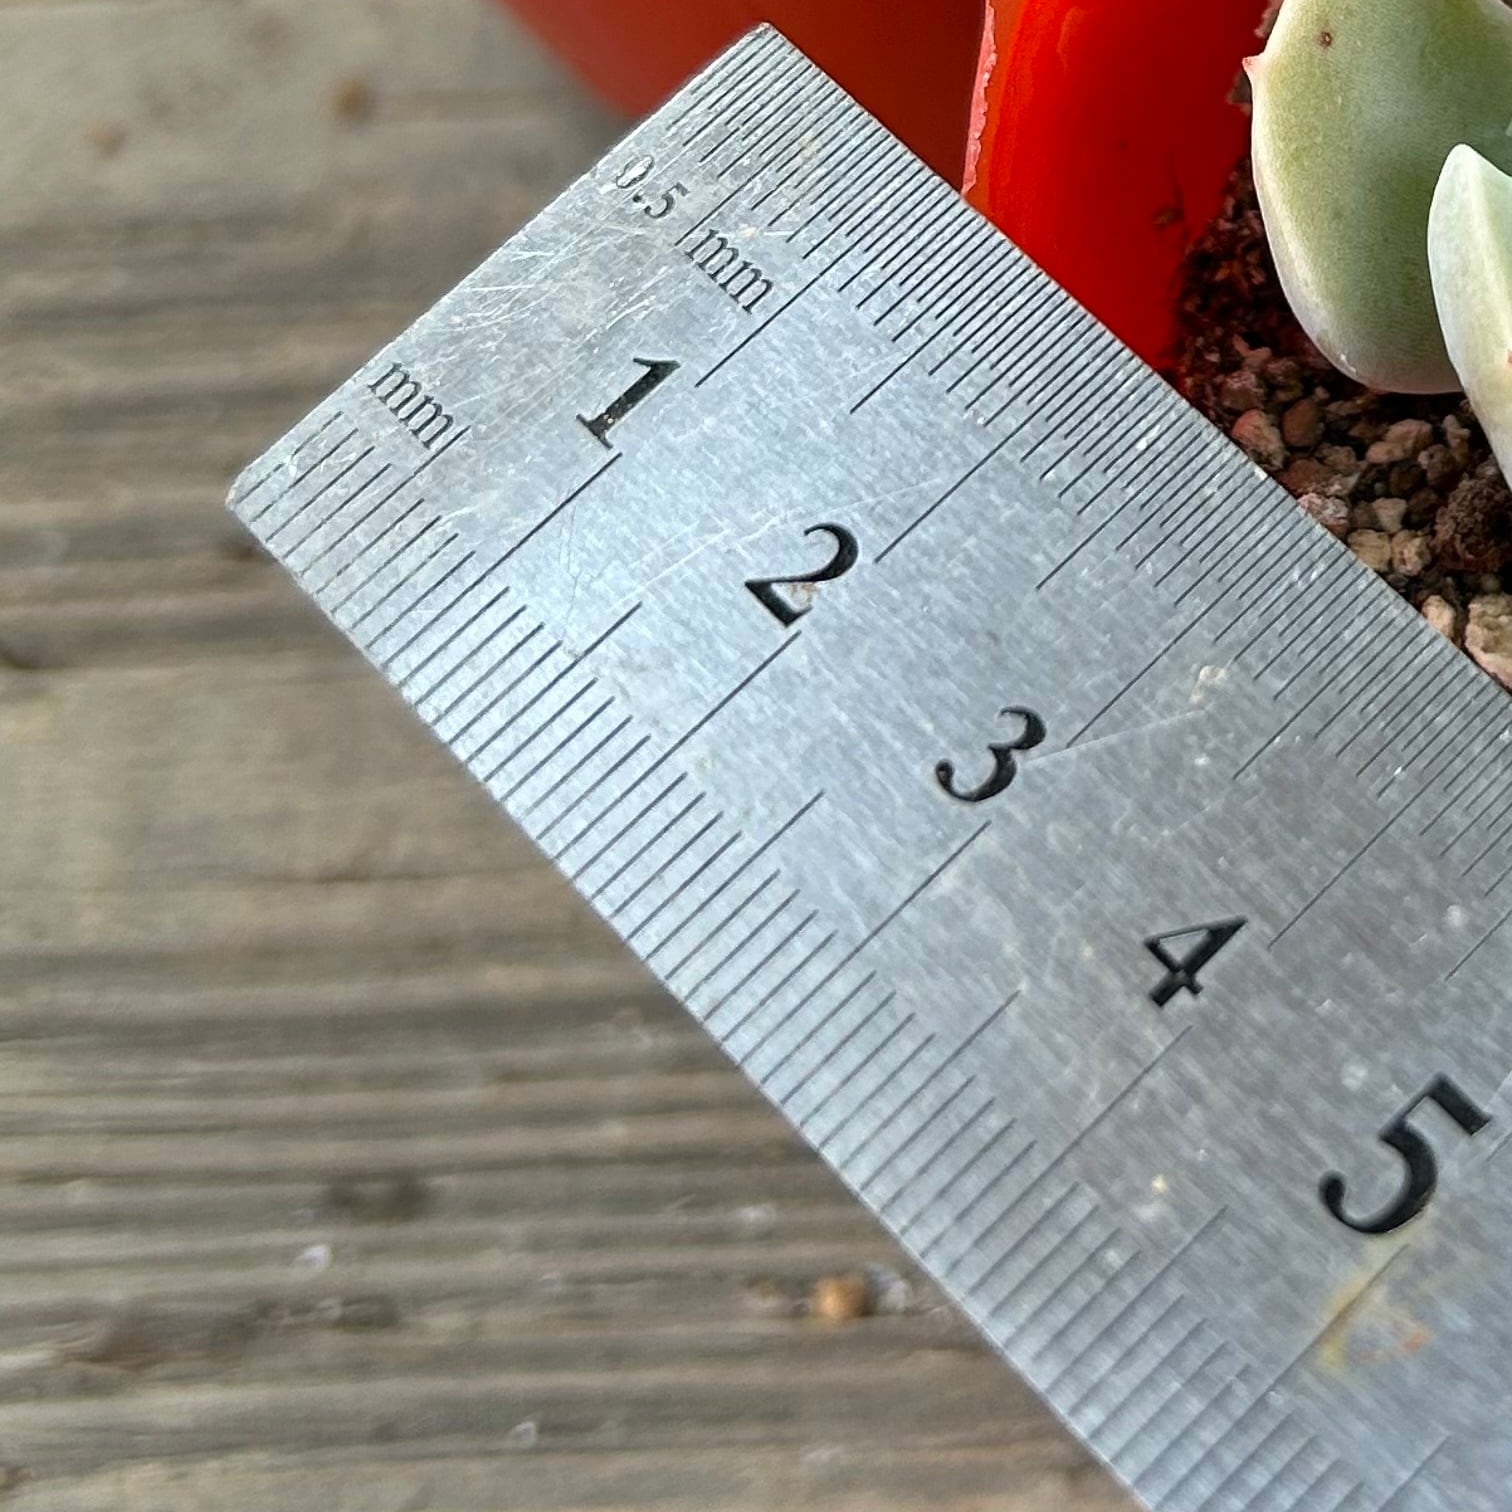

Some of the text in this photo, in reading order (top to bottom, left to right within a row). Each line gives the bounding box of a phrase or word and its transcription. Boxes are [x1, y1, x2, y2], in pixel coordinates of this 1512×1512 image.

[615, 153, 775, 315] 0.5 mm
[366, 362, 461, 450] mm
[575, 357, 682, 450] 1
[744, 521, 861, 629] 2
[933, 705, 1047, 803] 3
[1143, 915, 1249, 1009] 4
[1317, 1072, 1493, 1236] 5
